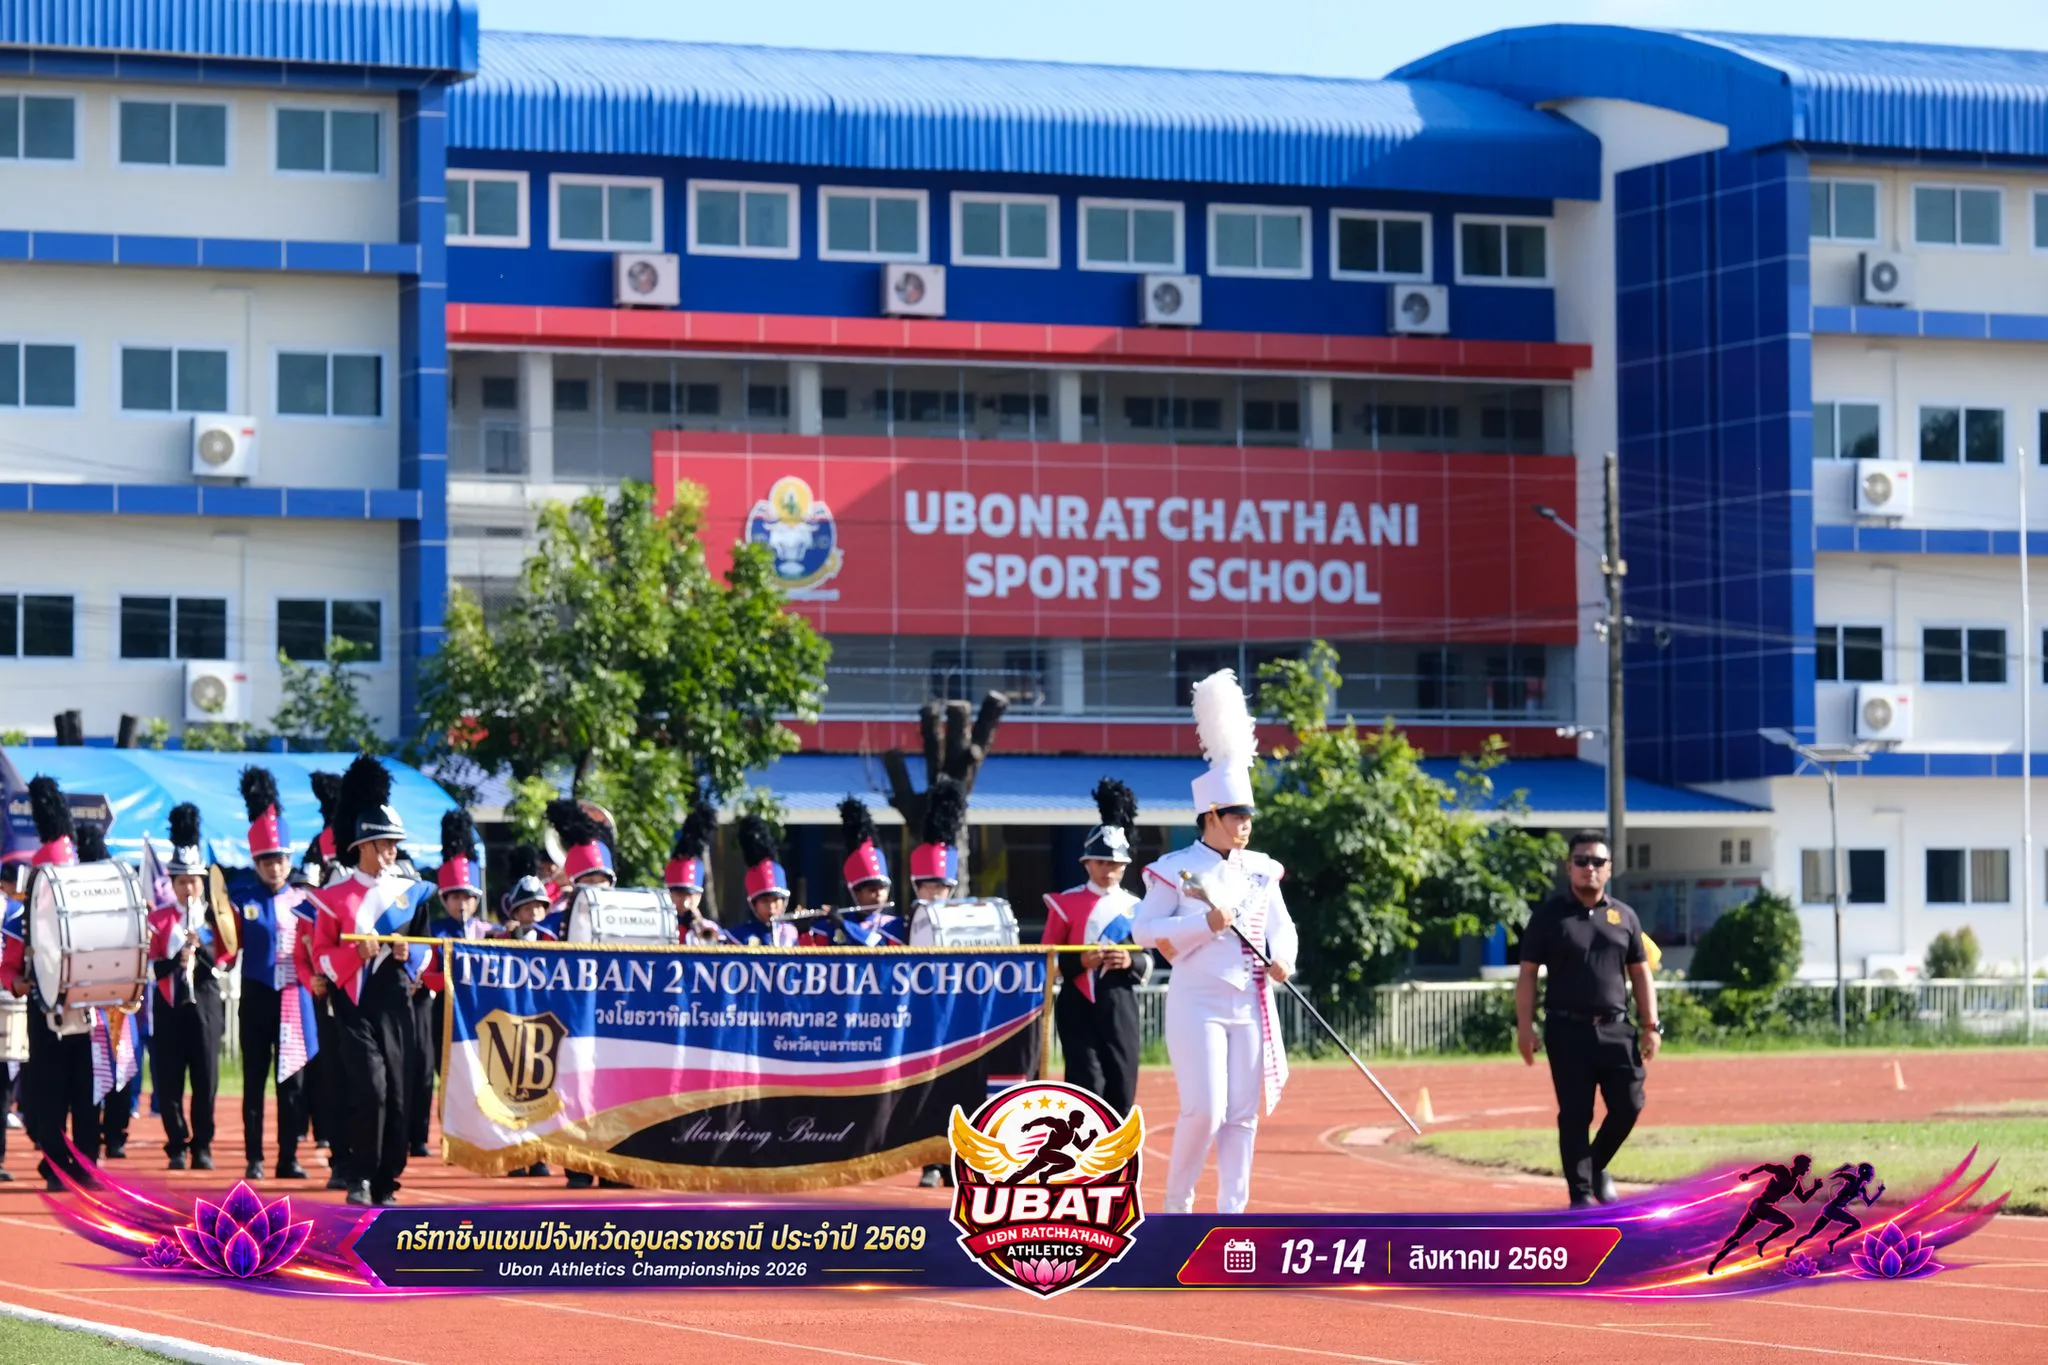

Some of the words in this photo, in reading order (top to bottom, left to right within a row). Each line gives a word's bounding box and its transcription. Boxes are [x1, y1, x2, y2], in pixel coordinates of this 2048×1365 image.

[905, 489, 1419, 546] UBONRATCHATHANI
[966, 552, 1160, 600] SPORTS
[1188, 557, 1381, 605] SCHOOL
[618, 915, 657, 926] YAMAHA
[456, 951, 654, 993] TEDSABAN
[663, 960, 684, 993] 2
[693, 961, 881, 995] NONGBUA
[892, 961, 1045, 995] SCHOOL
[485, 1020, 556, 1098] NB
[672, 1116, 773, 1153] Marching
[778, 1116, 856, 1143] Band
